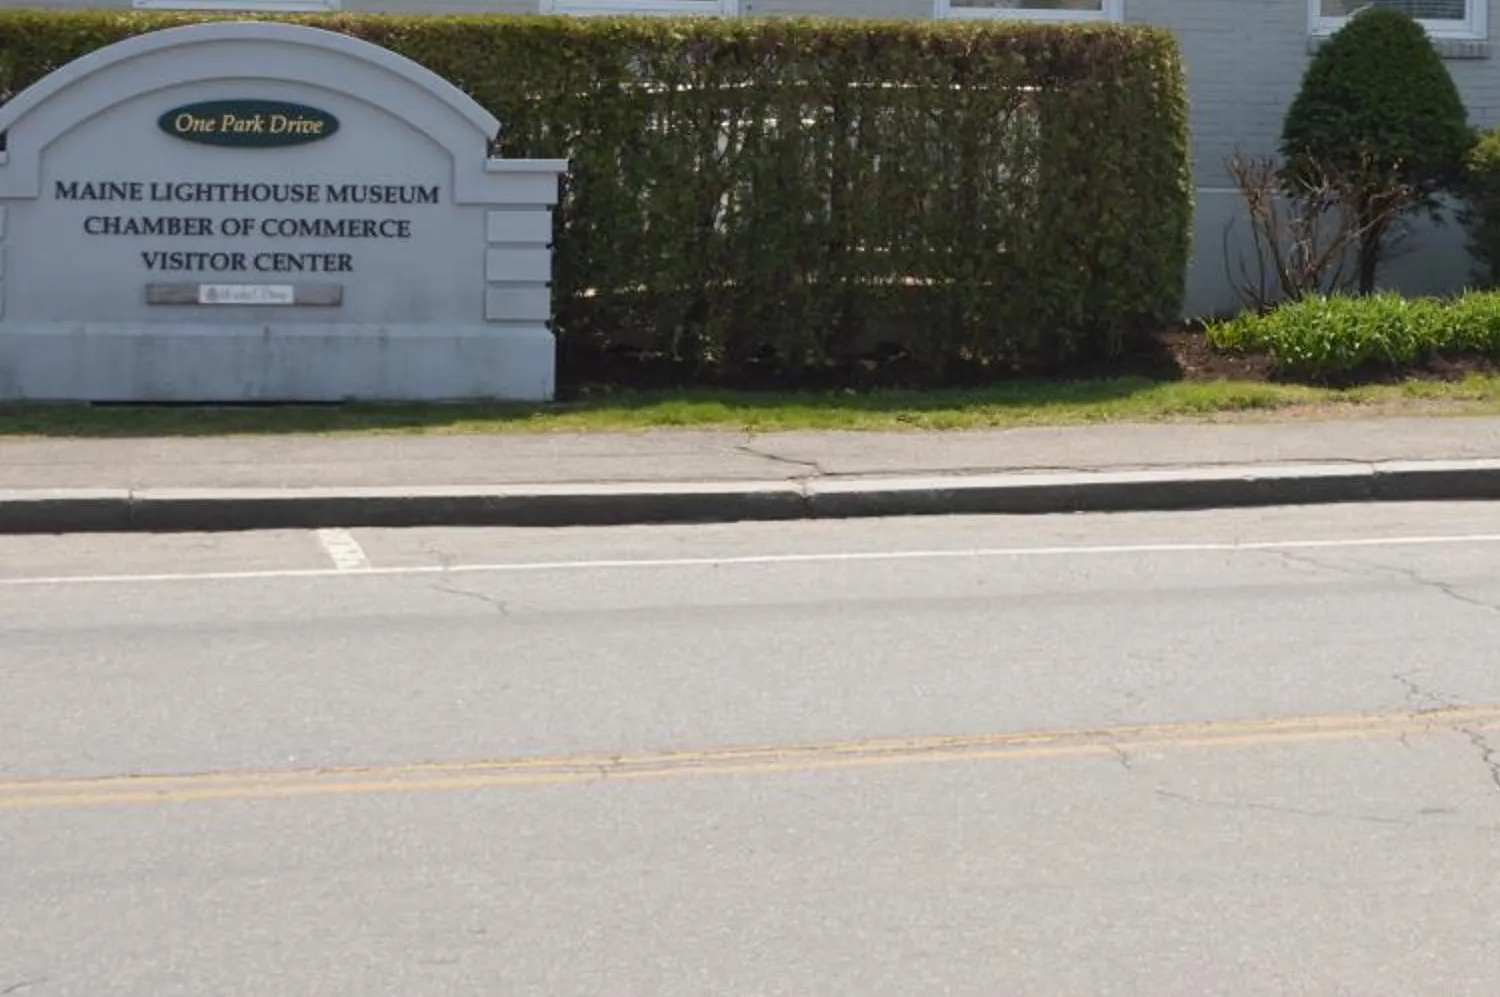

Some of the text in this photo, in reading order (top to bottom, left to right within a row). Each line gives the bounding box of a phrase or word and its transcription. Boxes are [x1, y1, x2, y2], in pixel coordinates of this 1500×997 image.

[174, 113, 325, 135] One Park Drive
[54, 180, 440, 204] MAINE LIGHTHOUSE MUSEUM
[82, 216, 412, 239] CHAMBER OF COMMERCE
[140, 251, 354, 273] VISITOR CENTER
